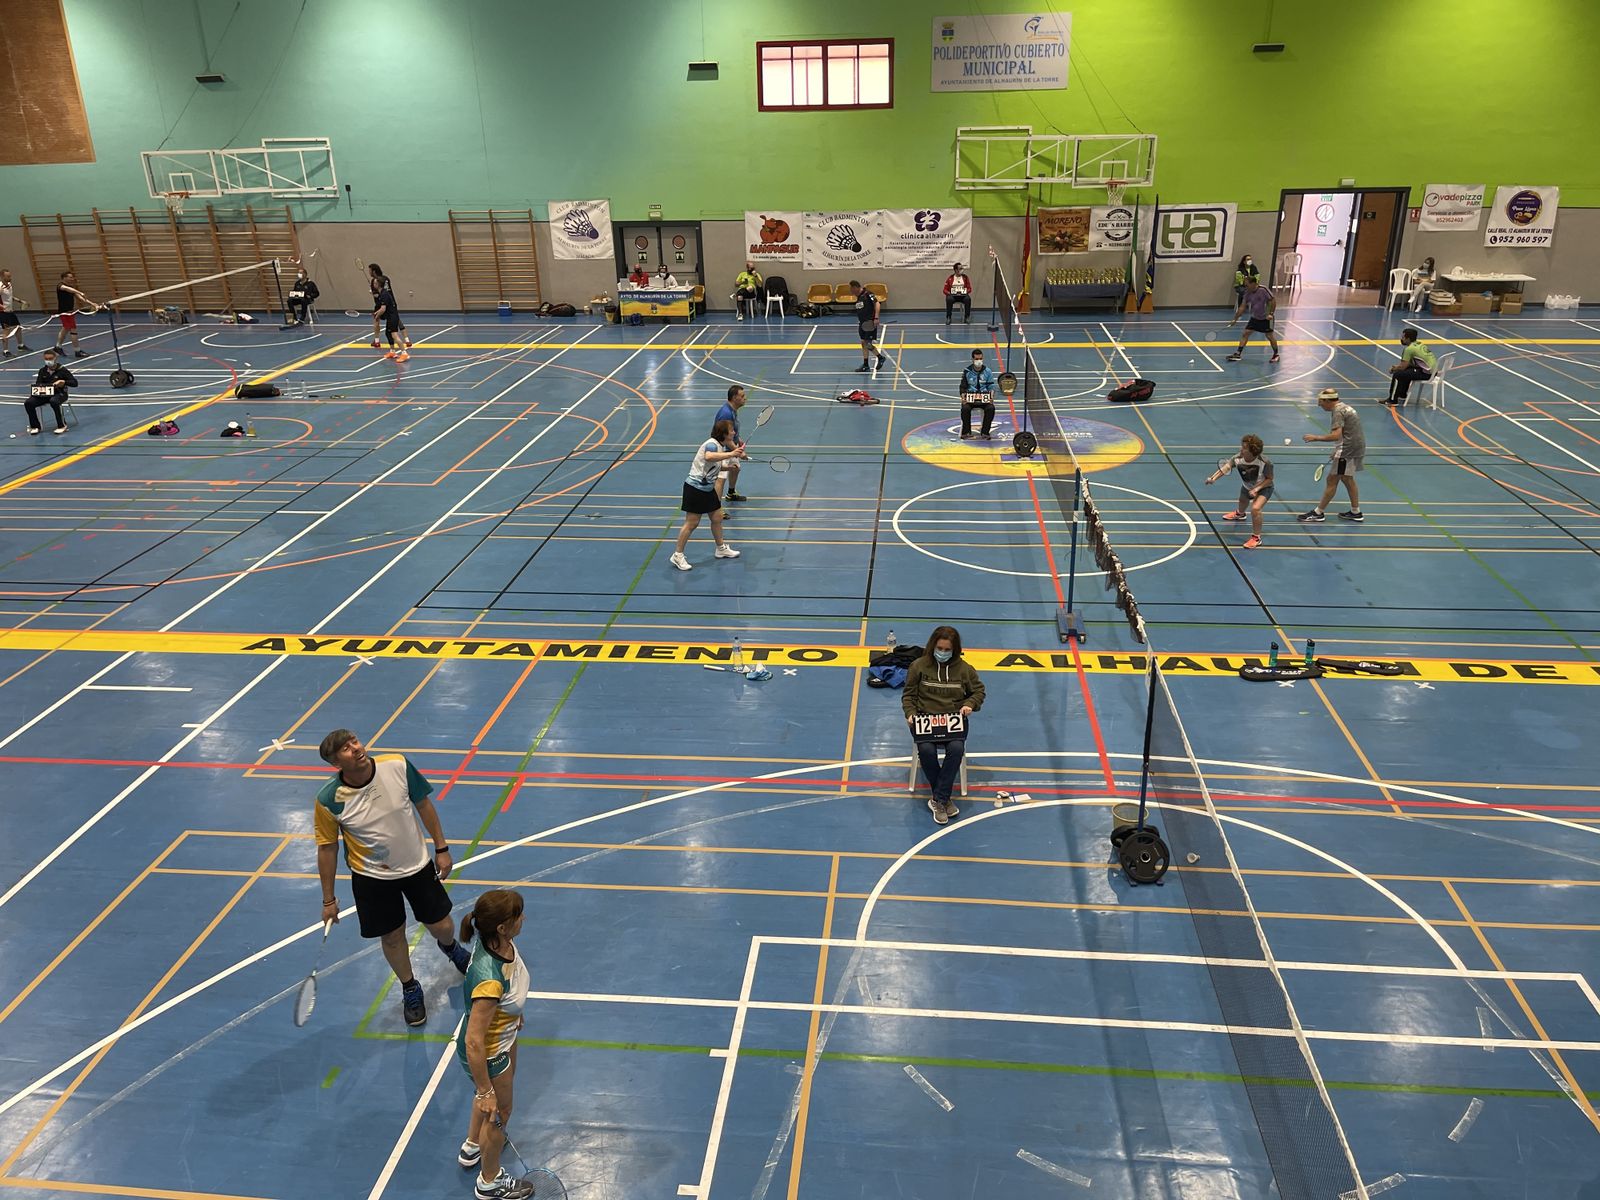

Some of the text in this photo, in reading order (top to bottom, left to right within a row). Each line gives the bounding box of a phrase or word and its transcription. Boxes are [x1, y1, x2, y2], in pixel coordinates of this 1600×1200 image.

[933, 43, 1065, 60] POLIDEPORTIVO CUBIERTO
[963, 60, 1036, 76] MUNICIPAL
[818, 214, 871, 228] CLUB BADMINTON
[1044, 217, 1082, 225] MORENO
[967, 394, 974, 402] 11
[240, 637, 838, 662] AYUNTAMIENTO
[1449, 662, 1568, 680] DE
[917, 715, 962, 734] 12 0 0 2
